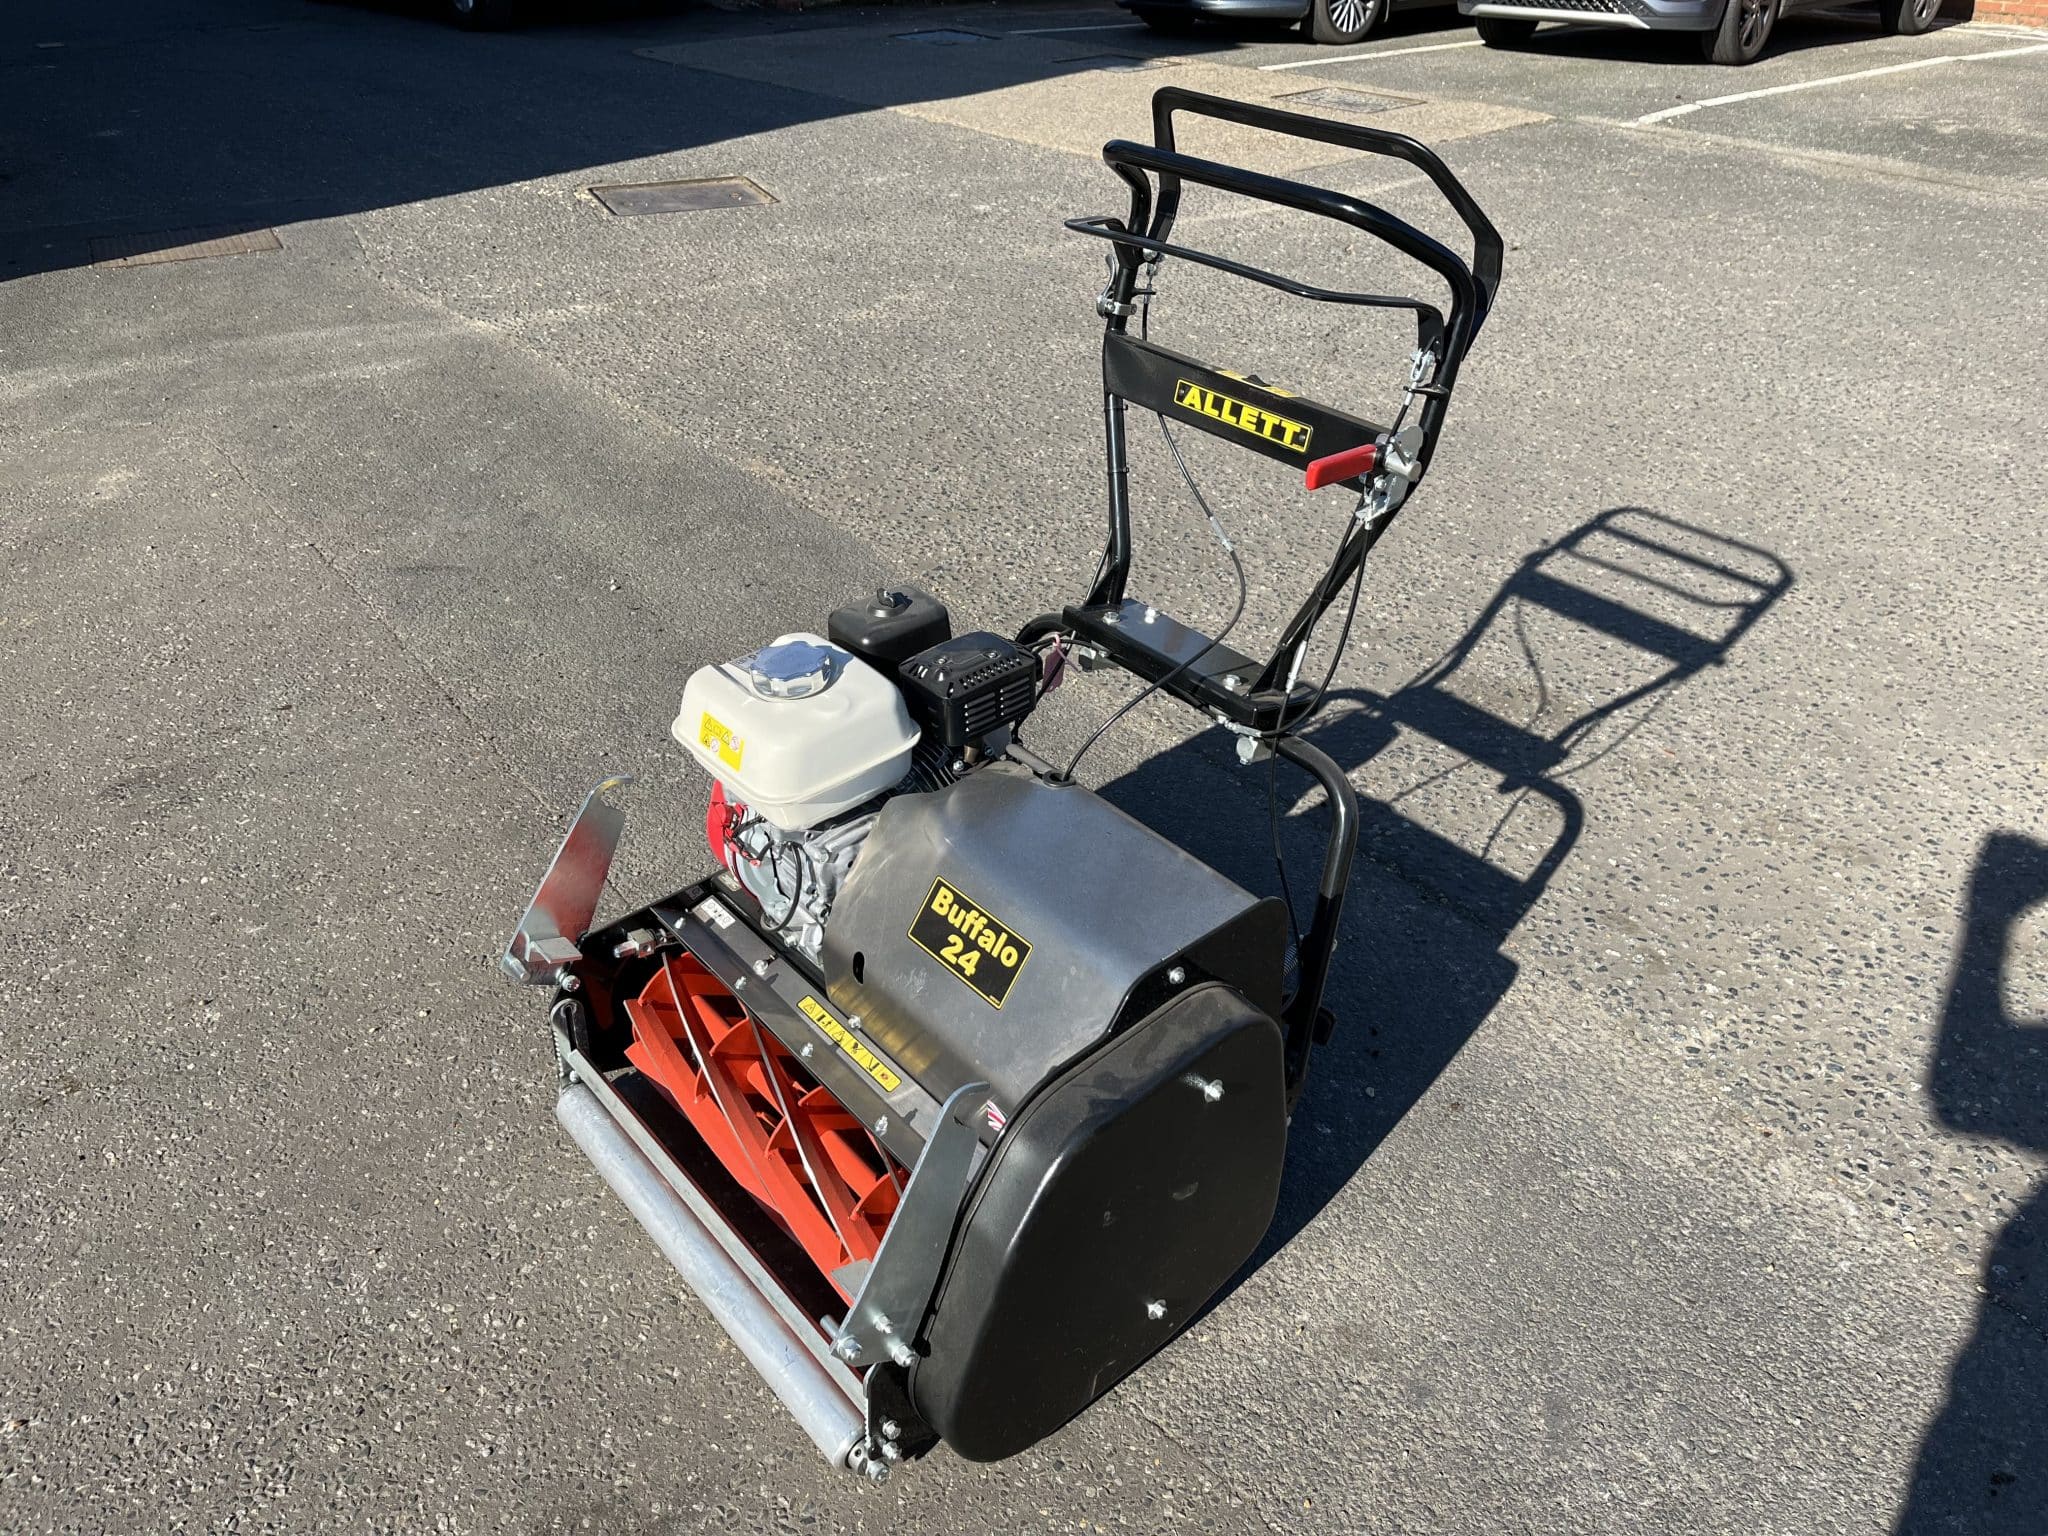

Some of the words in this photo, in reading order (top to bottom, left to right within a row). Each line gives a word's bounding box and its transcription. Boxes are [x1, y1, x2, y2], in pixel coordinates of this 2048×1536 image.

[1182, 386, 1302, 445] ALLETT
[930, 886, 1019, 968] Buffalo
[939, 933, 981, 977] 24
